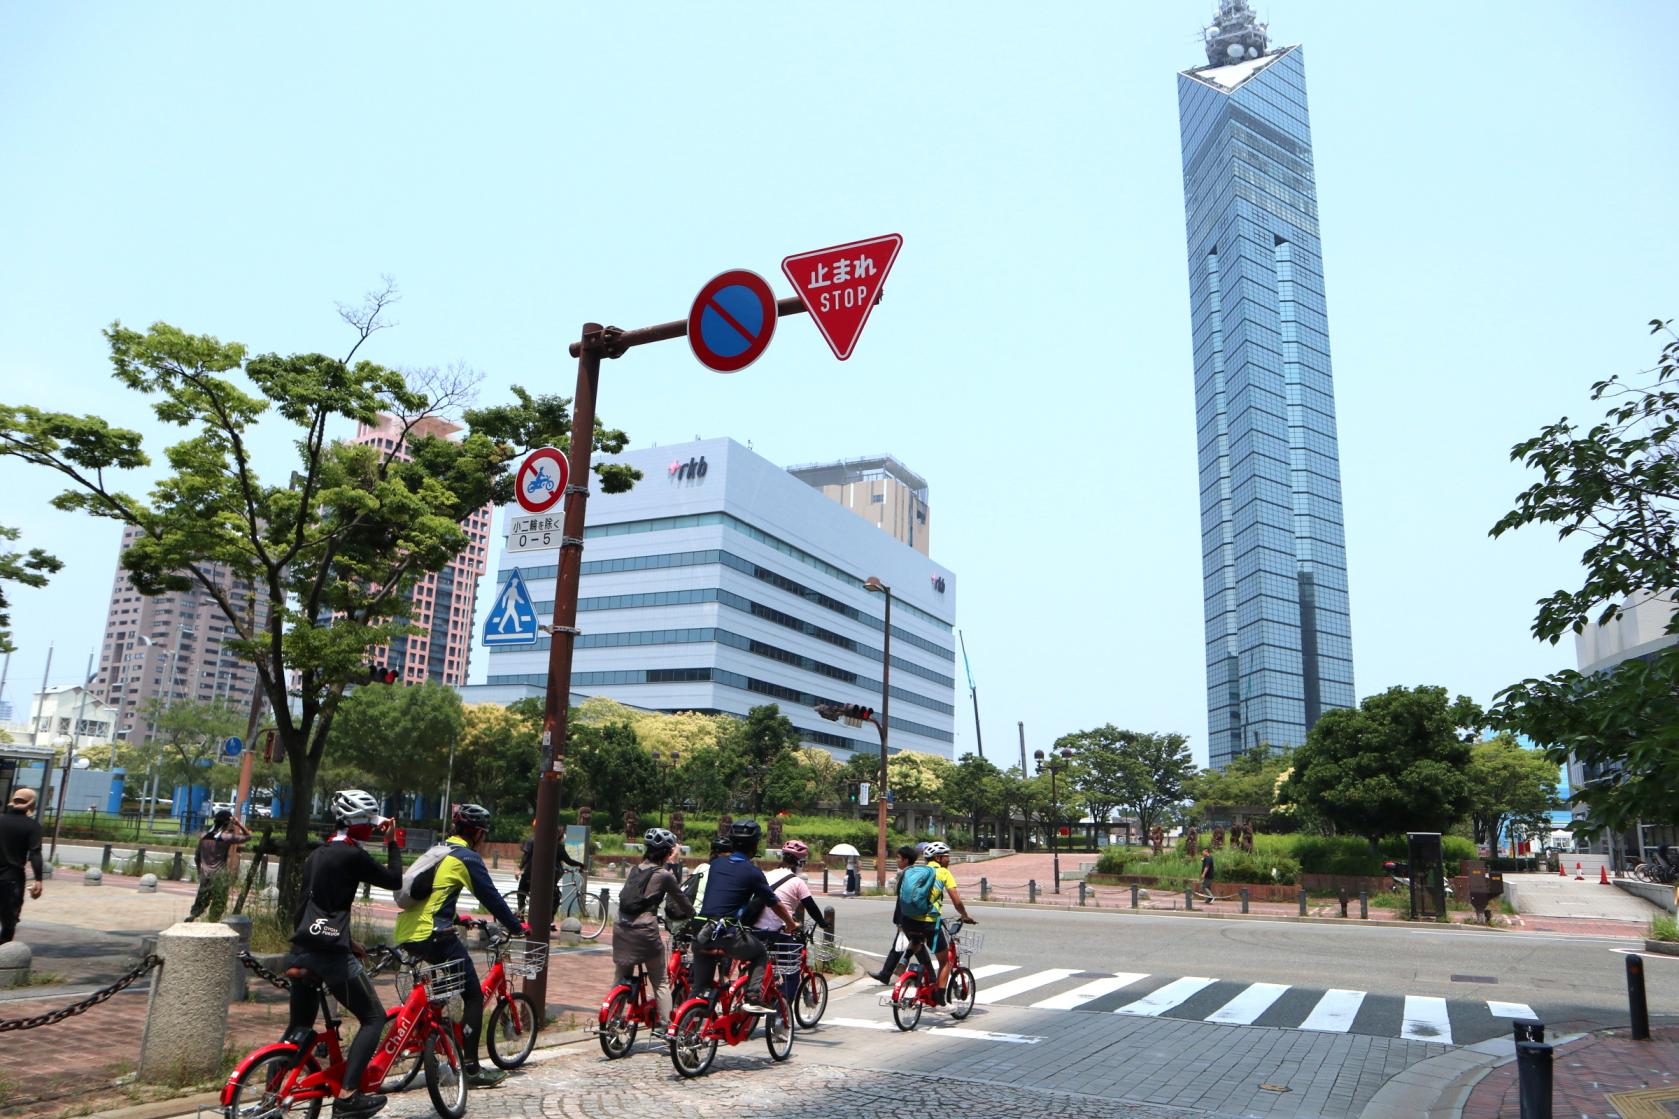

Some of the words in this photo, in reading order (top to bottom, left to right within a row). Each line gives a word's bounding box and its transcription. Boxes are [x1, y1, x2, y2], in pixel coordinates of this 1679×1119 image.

[808, 254, 877, 289] 止まれ
[820, 285, 867, 312] STOP
[678, 456, 708, 480] rkb
[513, 518, 560, 533] 小二輪を除く
[385, 1016, 411, 1054] Chari
